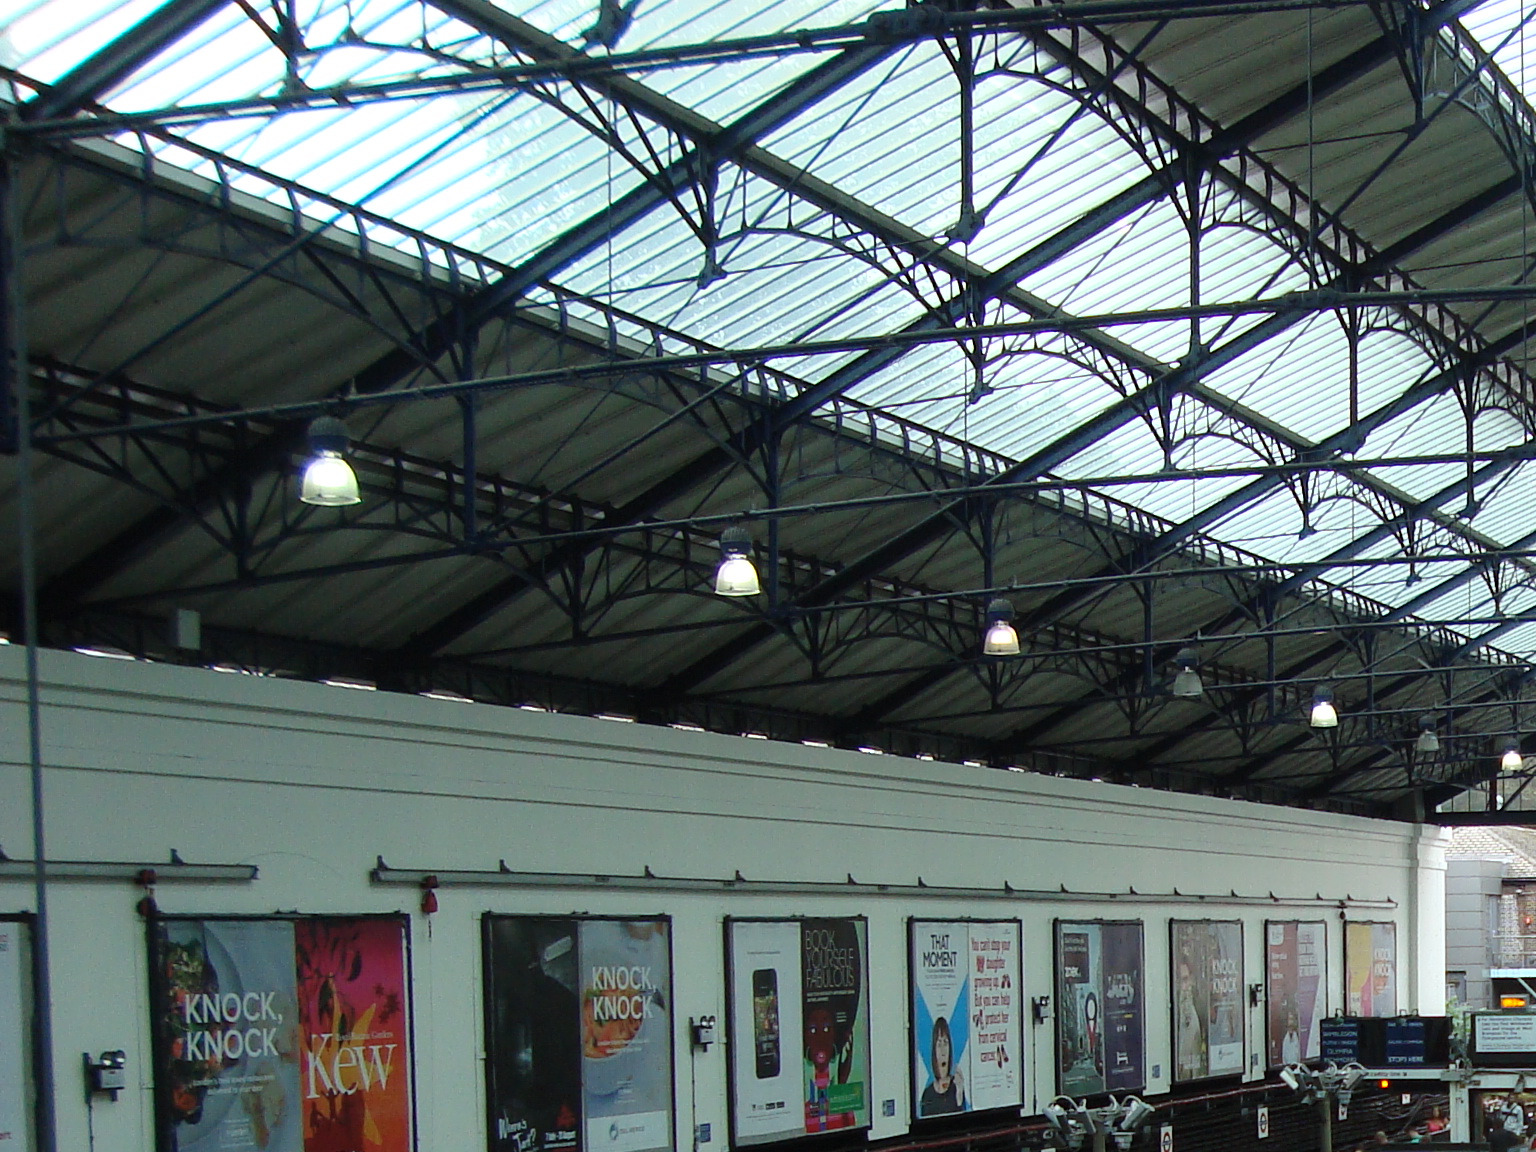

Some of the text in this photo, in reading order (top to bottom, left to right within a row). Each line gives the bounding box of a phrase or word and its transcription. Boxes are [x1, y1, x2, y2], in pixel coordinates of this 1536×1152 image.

[805, 929, 835, 949] BOOK
[930, 934, 949, 949] THAT
[806, 948, 854, 968] YOURSELF
[923, 951, 957, 967] MOMENT
[592, 966, 657, 993] KNOCK,
[806, 967, 854, 988] FABULOUS
[1212, 978, 1237, 993] KNOCK
[185, 991, 282, 1024] KNOCK,
[593, 995, 653, 1020] KNOCK
[186, 1028, 278, 1061] KNOCK
[306, 1033, 397, 1098] Kew
